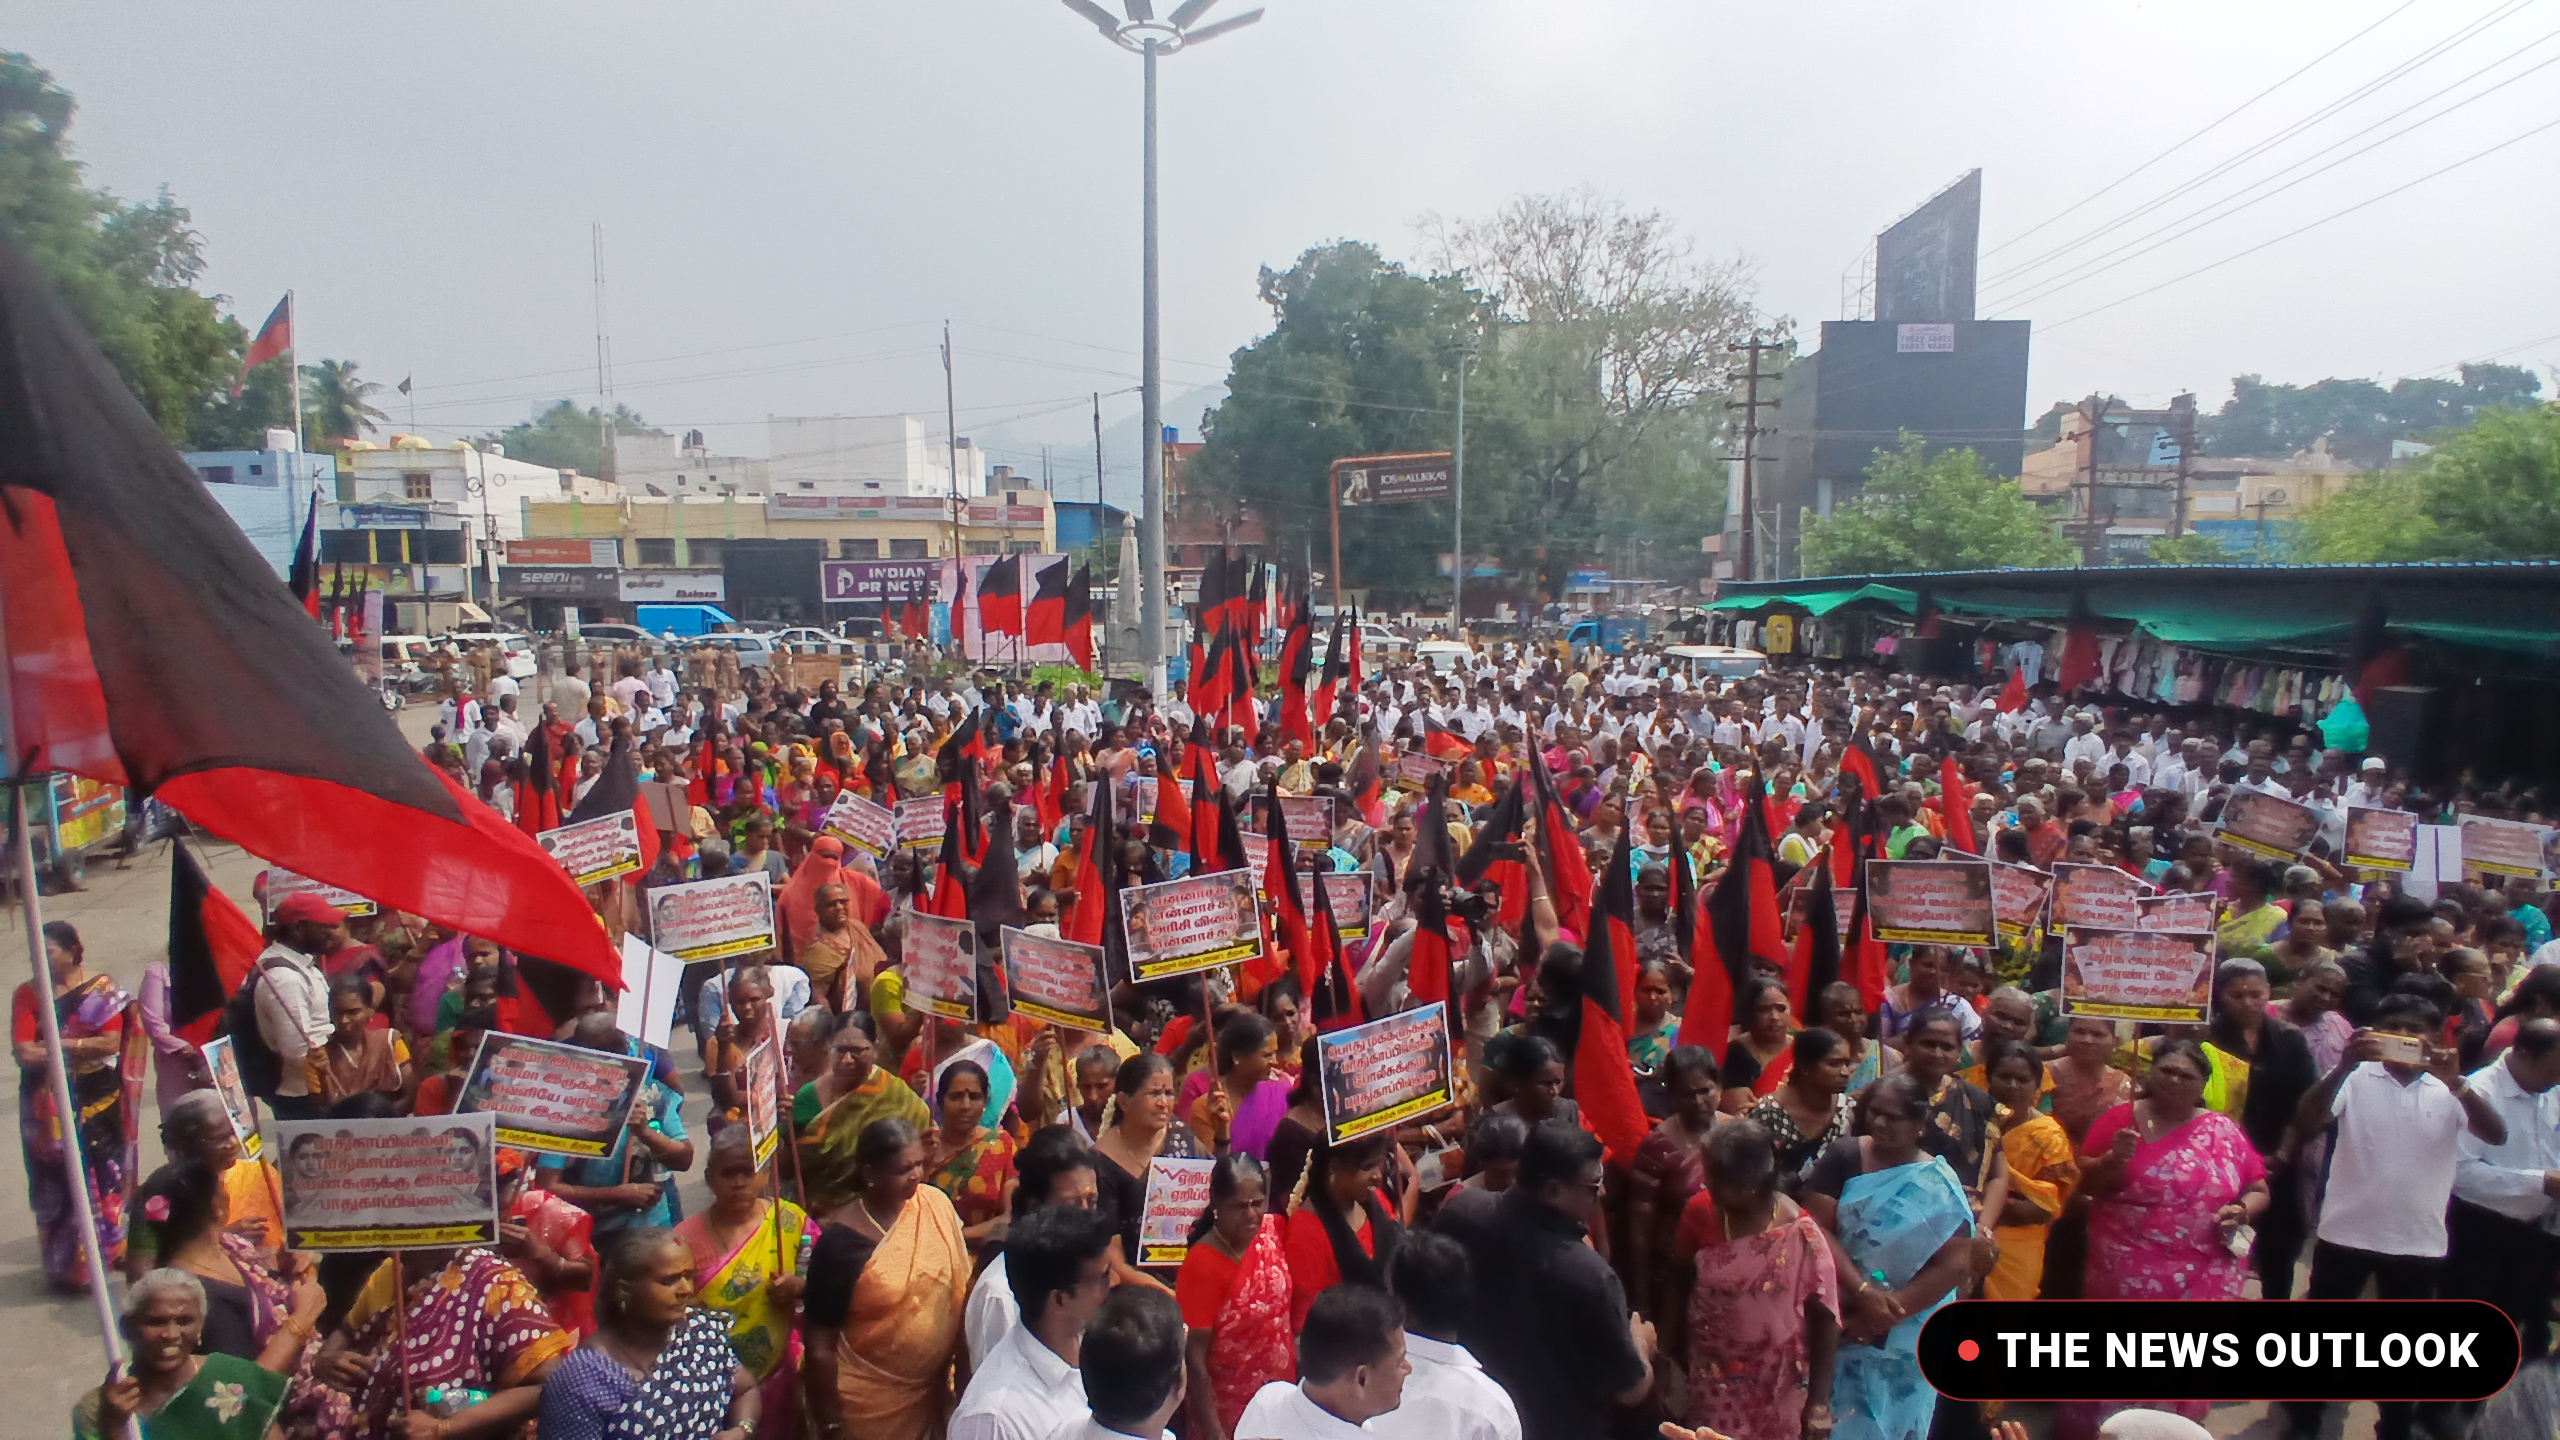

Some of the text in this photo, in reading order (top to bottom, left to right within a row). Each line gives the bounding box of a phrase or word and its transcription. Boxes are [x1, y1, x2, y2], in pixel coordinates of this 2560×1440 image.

[1380, 474, 1397, 485] JOS
[520, 572, 569, 583] seeni
[868, 567, 926, 578] INDIAN
[1149, 919, 1191, 936] அரிசி
[1328, 1043, 1365, 1060] பொது
[319, 1194, 454, 1213] பாதுகாப்பில்லை
